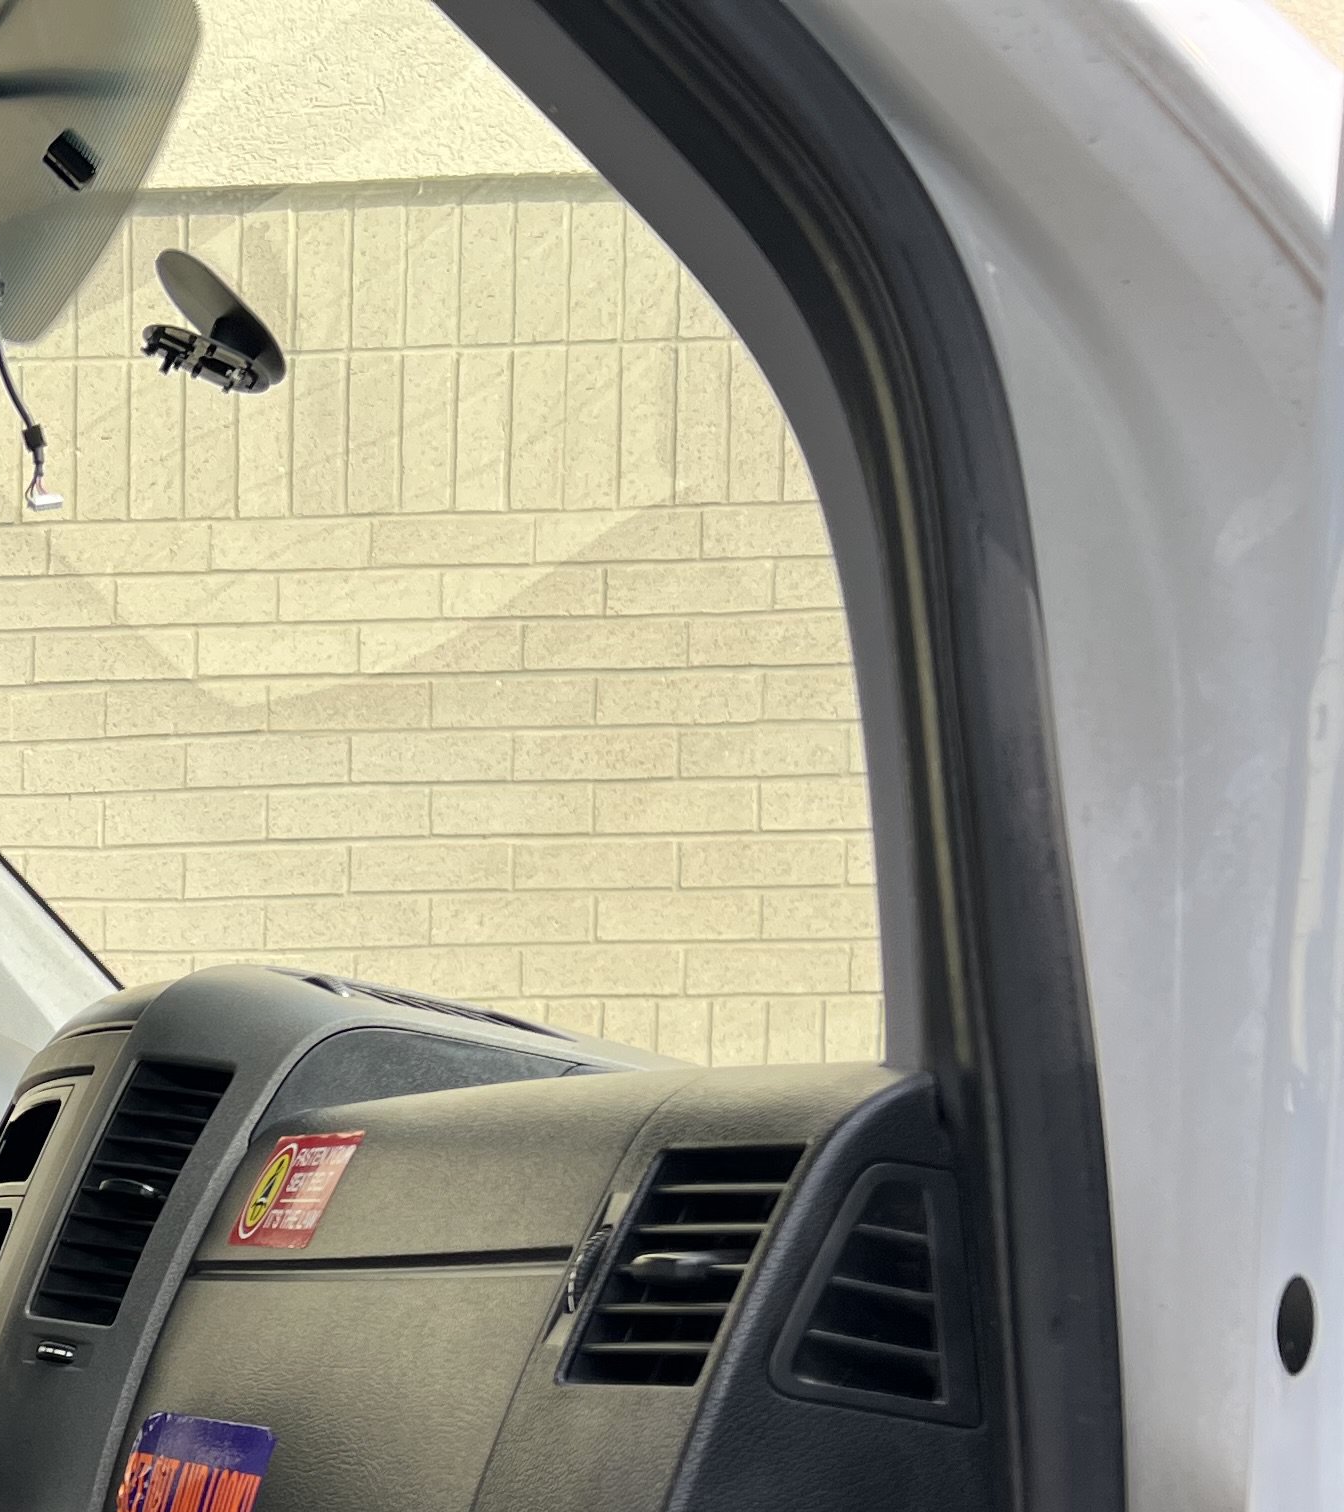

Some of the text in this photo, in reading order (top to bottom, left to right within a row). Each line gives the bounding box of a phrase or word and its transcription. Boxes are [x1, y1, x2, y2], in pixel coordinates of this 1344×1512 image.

[295, 1144, 357, 1167] FASTEN YOUR
[286, 1171, 335, 1192] SEAT BELT
[279, 1209, 304, 1229] THE
[295, 1209, 322, 1229] LAW
